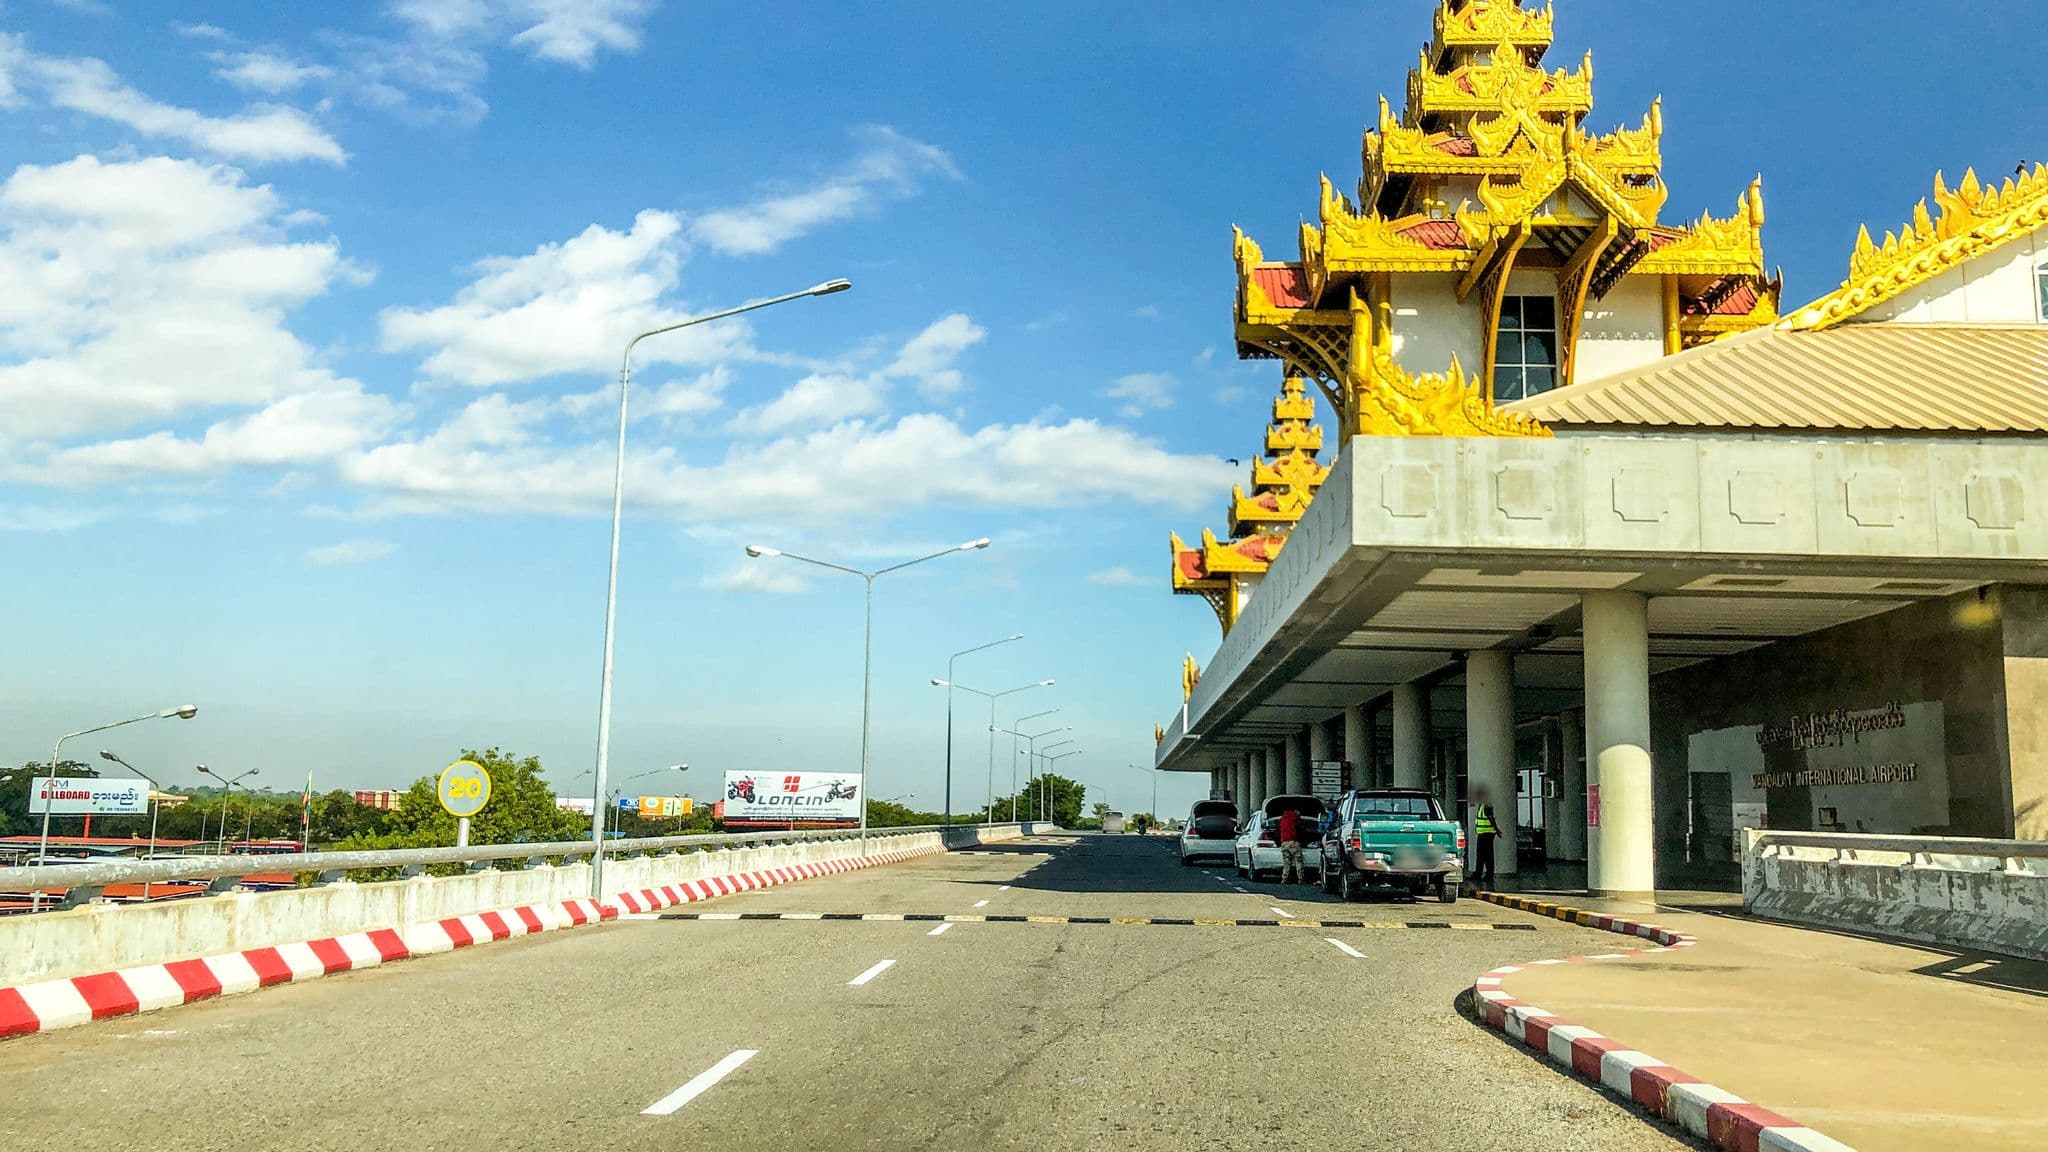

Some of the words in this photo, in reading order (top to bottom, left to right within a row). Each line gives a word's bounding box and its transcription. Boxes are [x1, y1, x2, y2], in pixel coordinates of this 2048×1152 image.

[1796, 766, 1866, 786] INTERNATIONAL
[1871, 763, 1915, 784] AIRPORT
[41, 790, 90, 799] BLLBOARD
[448, 776, 482, 799] 20
[758, 795, 823, 806] LONCIN
